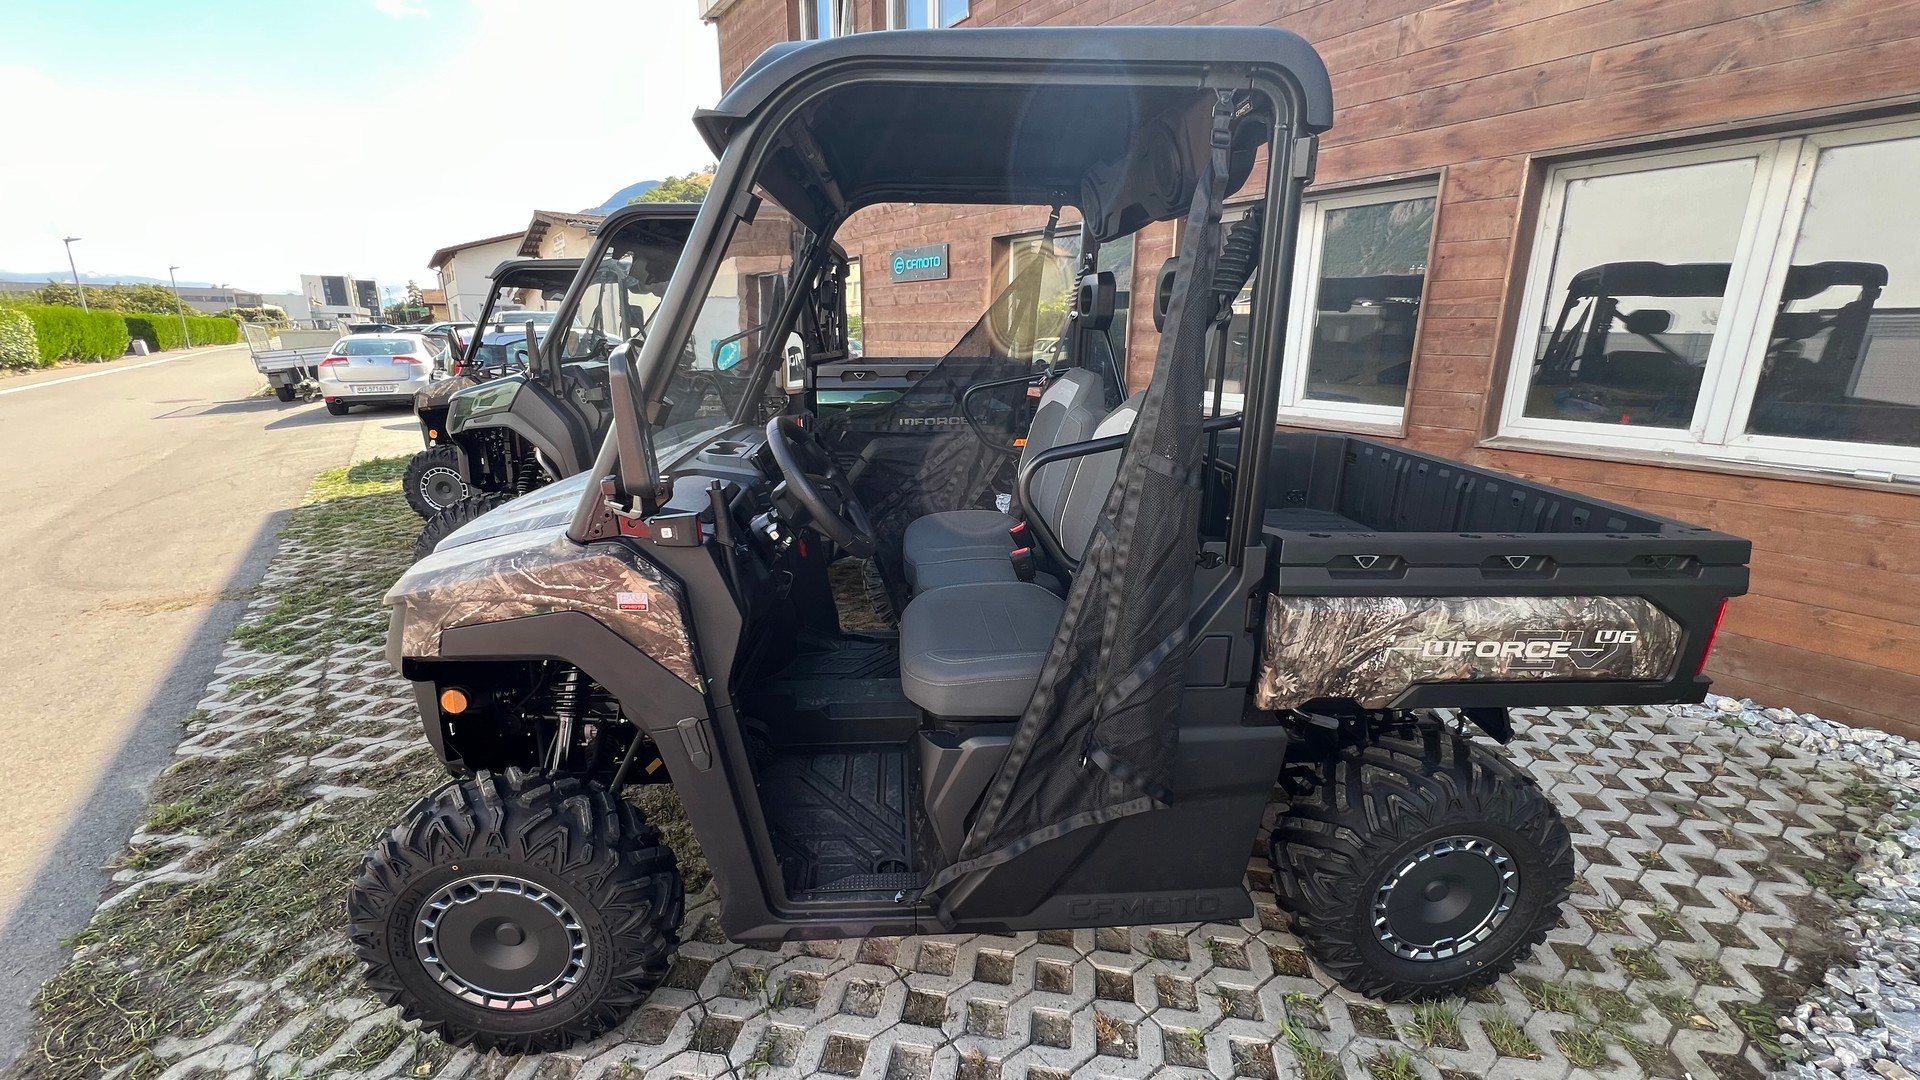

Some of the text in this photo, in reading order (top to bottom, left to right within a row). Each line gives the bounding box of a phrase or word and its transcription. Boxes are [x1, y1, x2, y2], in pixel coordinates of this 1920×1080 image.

[1422, 630, 1639, 658] UFORCE U6
[1067, 893, 1221, 922] CFMOTO
